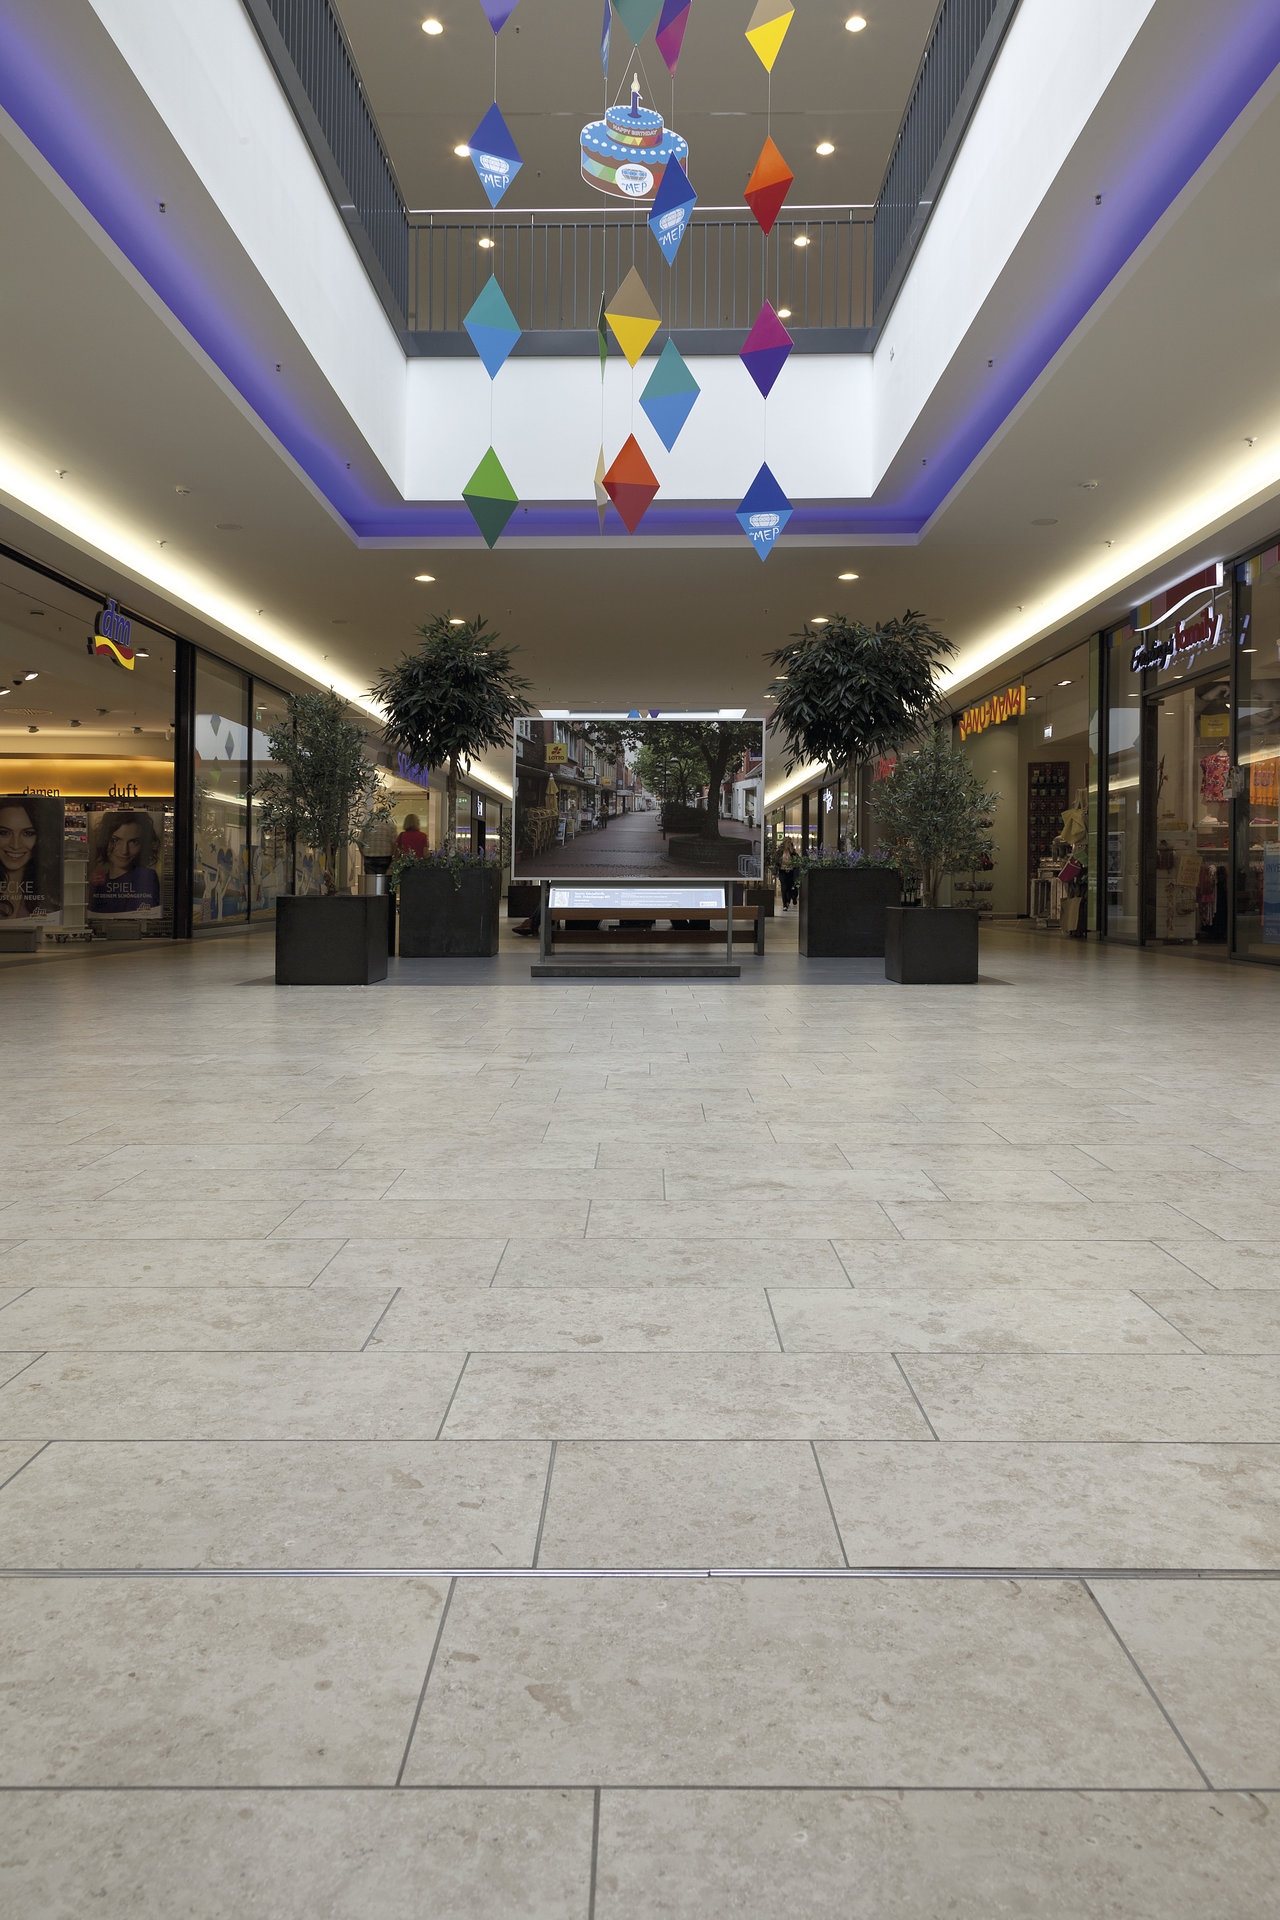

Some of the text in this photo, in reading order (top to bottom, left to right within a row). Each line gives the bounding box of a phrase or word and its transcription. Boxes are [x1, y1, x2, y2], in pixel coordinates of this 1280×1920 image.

[612, 123, 631, 135] HAPPY
[484, 173, 510, 189] MEP
[625, 181, 648, 194] MEP
[662, 223, 685, 246] MEP
[753, 527, 780, 543] MEP
[102, 598, 131, 647] dm
[1174, 606, 1221, 651] family
[959, 685, 1026, 741] NANU-NANA
[22, 786, 60, 797] damen
[108, 784, 138, 798] duft
[106, 882, 136, 893] SPIEL
